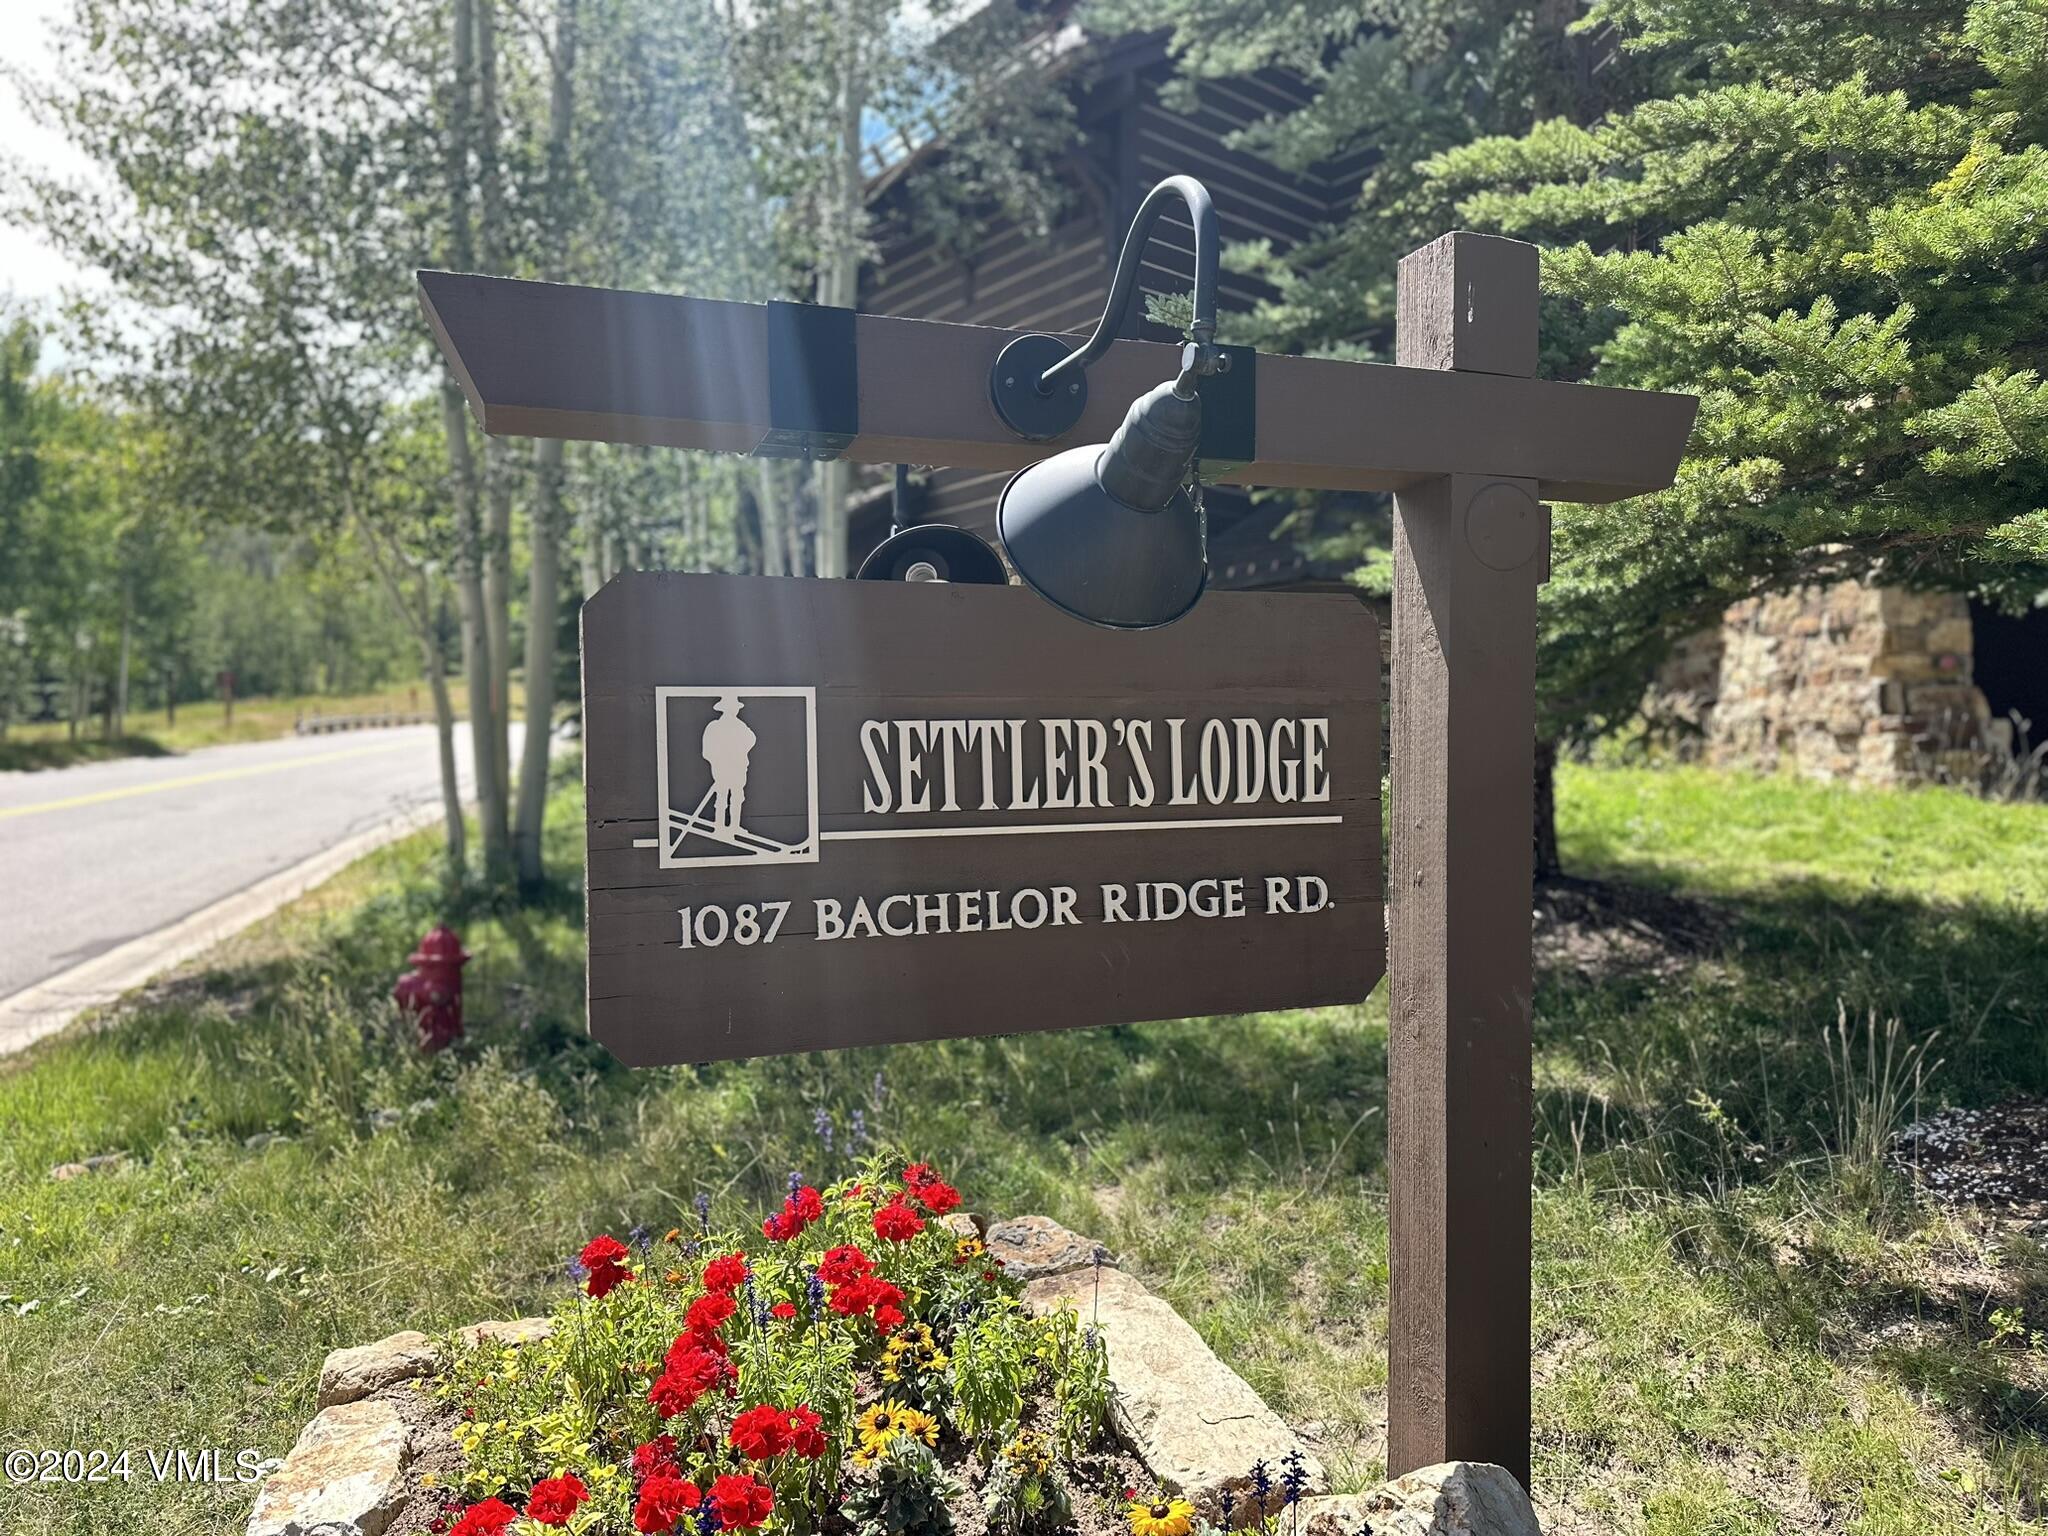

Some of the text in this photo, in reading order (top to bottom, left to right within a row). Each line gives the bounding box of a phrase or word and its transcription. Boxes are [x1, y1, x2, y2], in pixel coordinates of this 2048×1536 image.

[861, 717, 1330, 814] SETTLER'S LODGE
[678, 875, 1336, 949] 1087 BACHELOR RIDGE RD.
